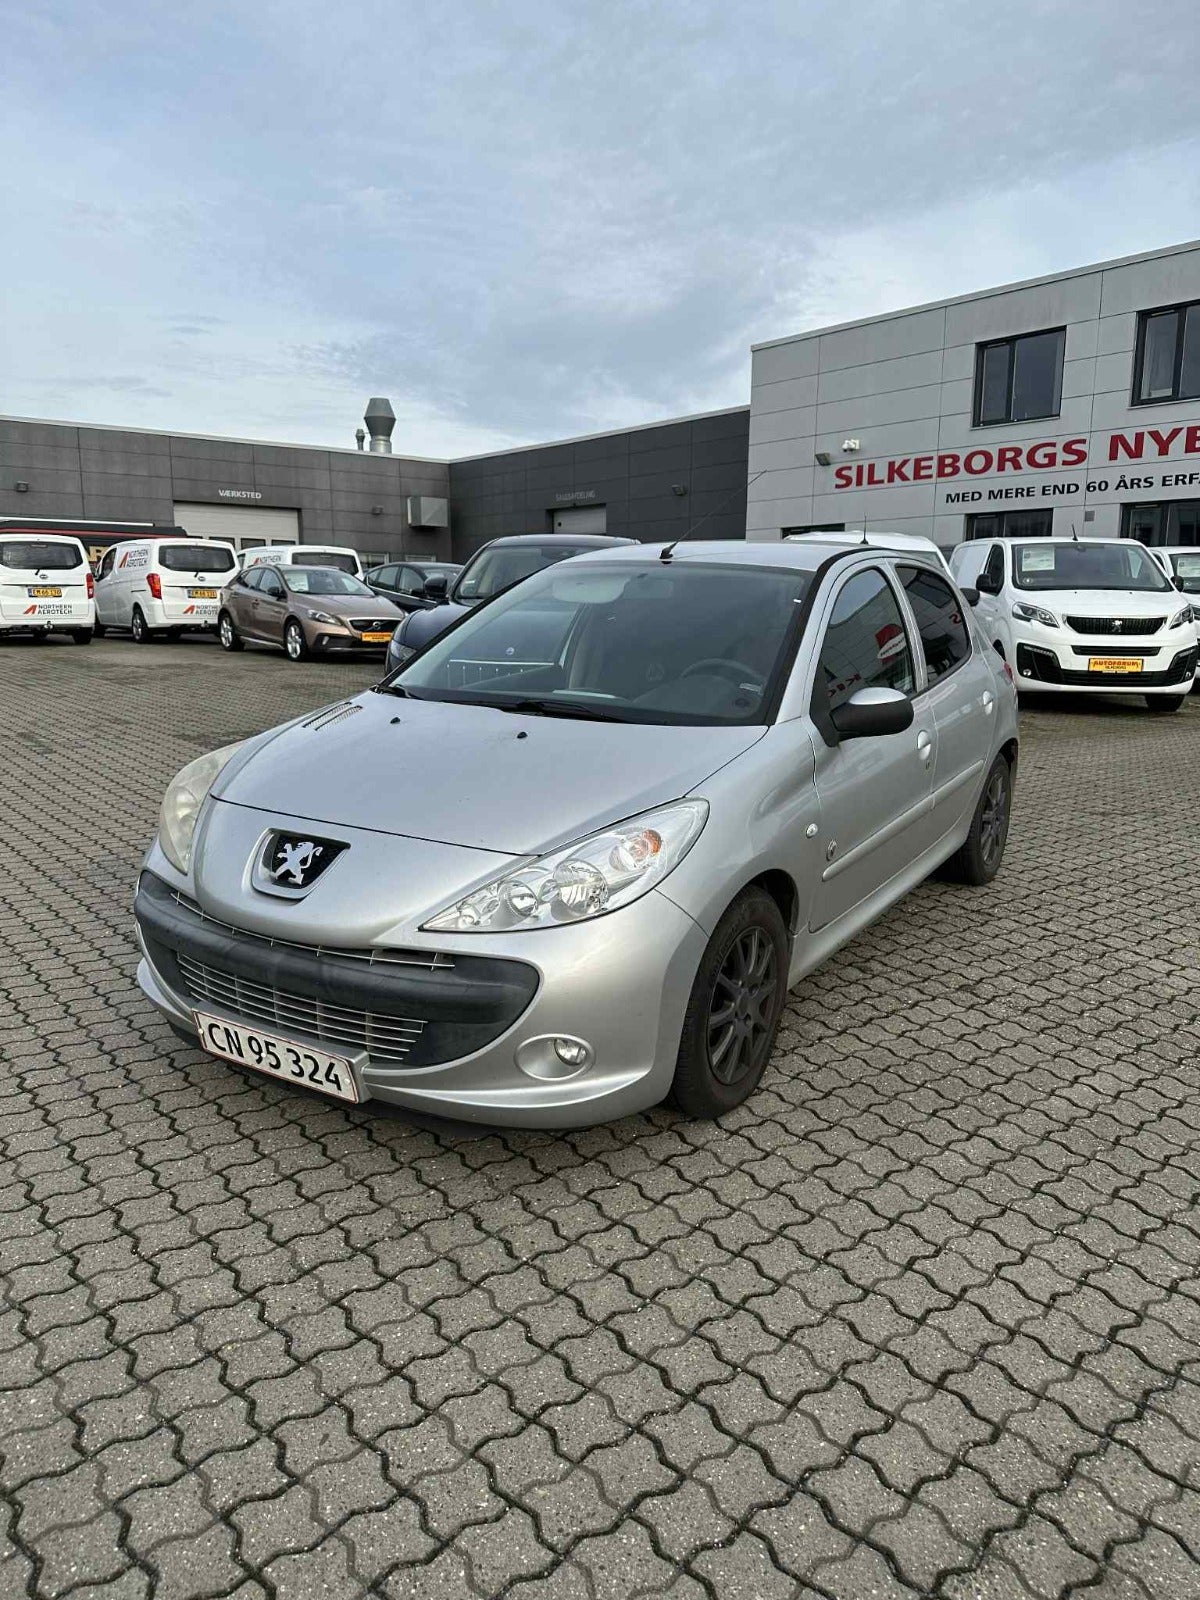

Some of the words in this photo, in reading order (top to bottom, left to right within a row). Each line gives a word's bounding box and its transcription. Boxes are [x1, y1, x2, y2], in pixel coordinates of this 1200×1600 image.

[834, 438, 1087, 489] SILKEBORGS
[218, 489, 262, 499] VÆRKSTED
[945, 489, 982, 504] MED
[987, 486, 1035, 500] MERE
[1041, 482, 1079, 496] END
[1086, 480, 1109, 492] 60
[1114, 474, 1154, 491] ÅRS
[1161, 472, 1200, 487] ERF
[208, 1023, 244, 1058] CN
[248, 1035, 281, 1070] 95
[286, 1047, 342, 1092] 324
